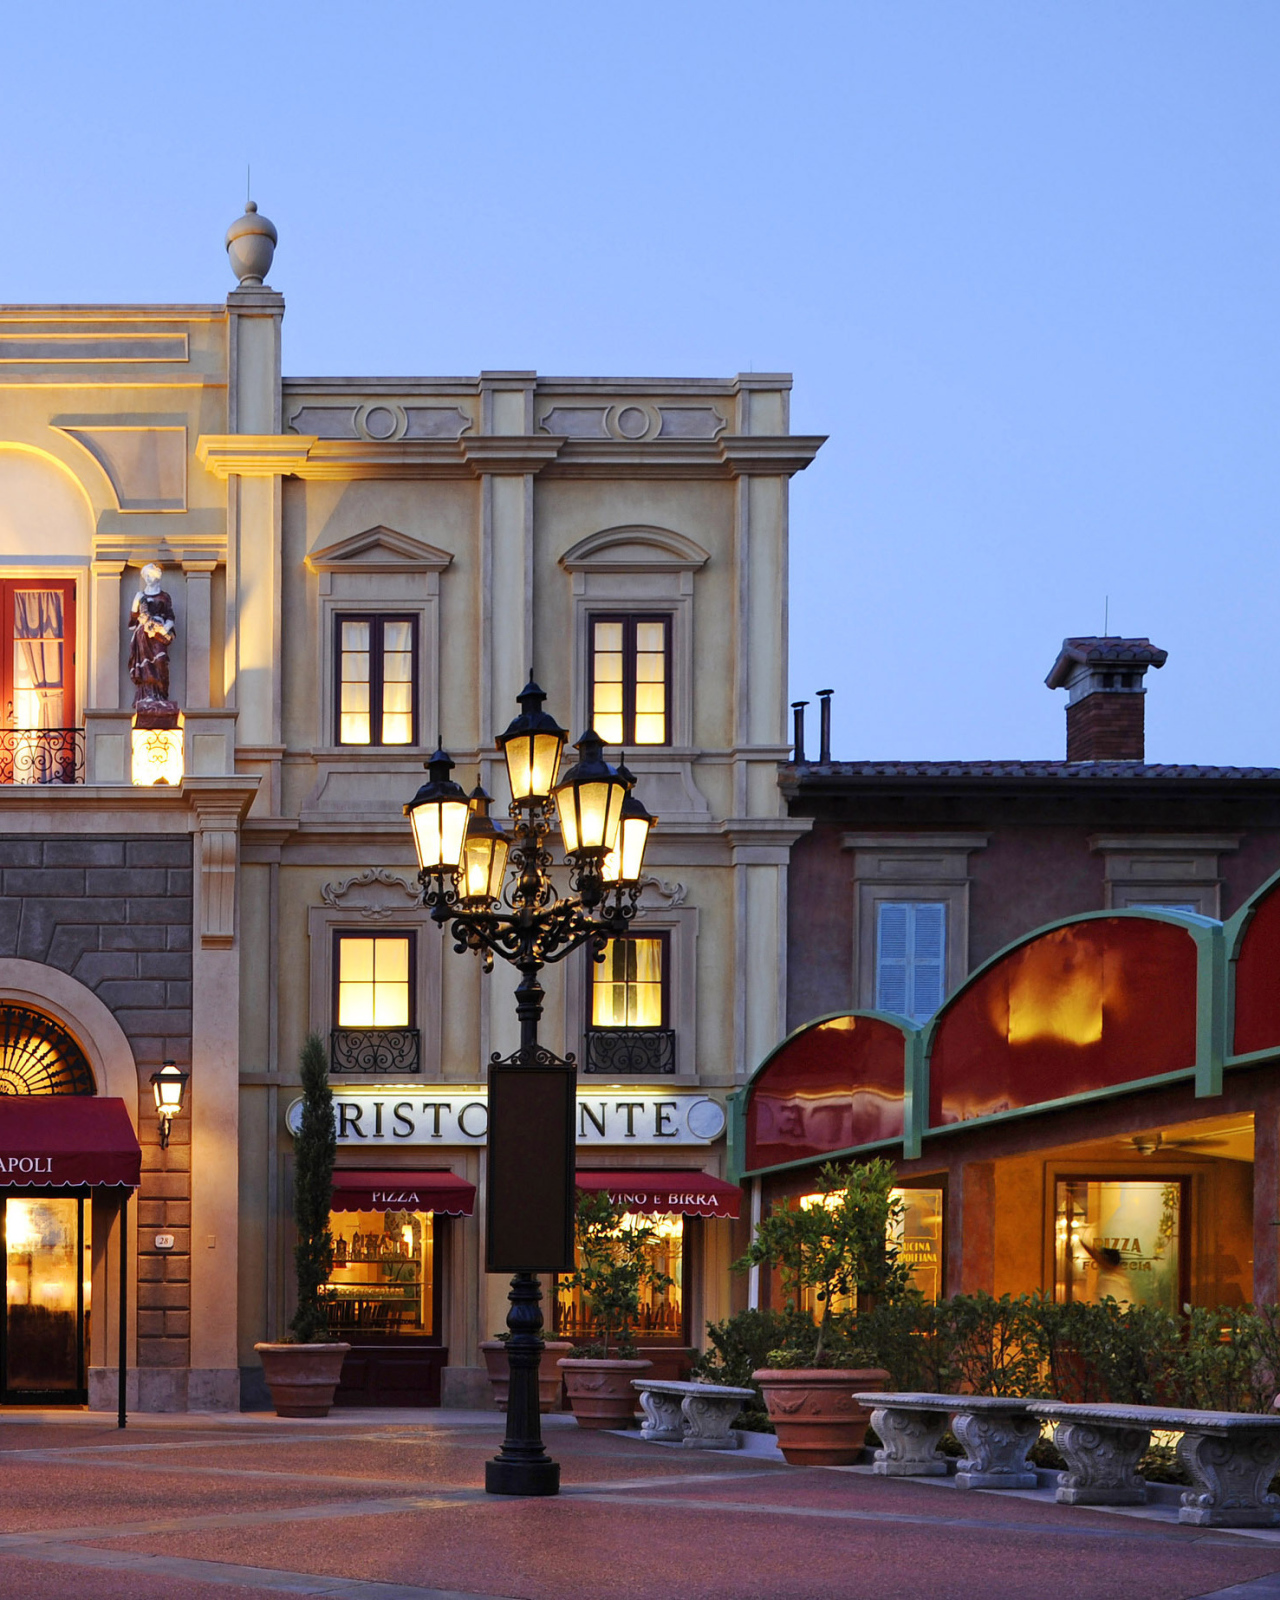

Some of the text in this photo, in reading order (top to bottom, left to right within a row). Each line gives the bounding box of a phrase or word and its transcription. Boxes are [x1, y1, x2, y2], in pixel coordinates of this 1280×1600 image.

[337, 1102, 680, 1138] RISTONTE
[371, 1191, 420, 1203] PIZZA
[606, 1192, 719, 1206] VINO E BIRRA
[159, 1237, 169, 1245] 28
[1093, 1238, 1142, 1253] PIZZA
[1082, 1261, 1152, 1271] FOCCIA
